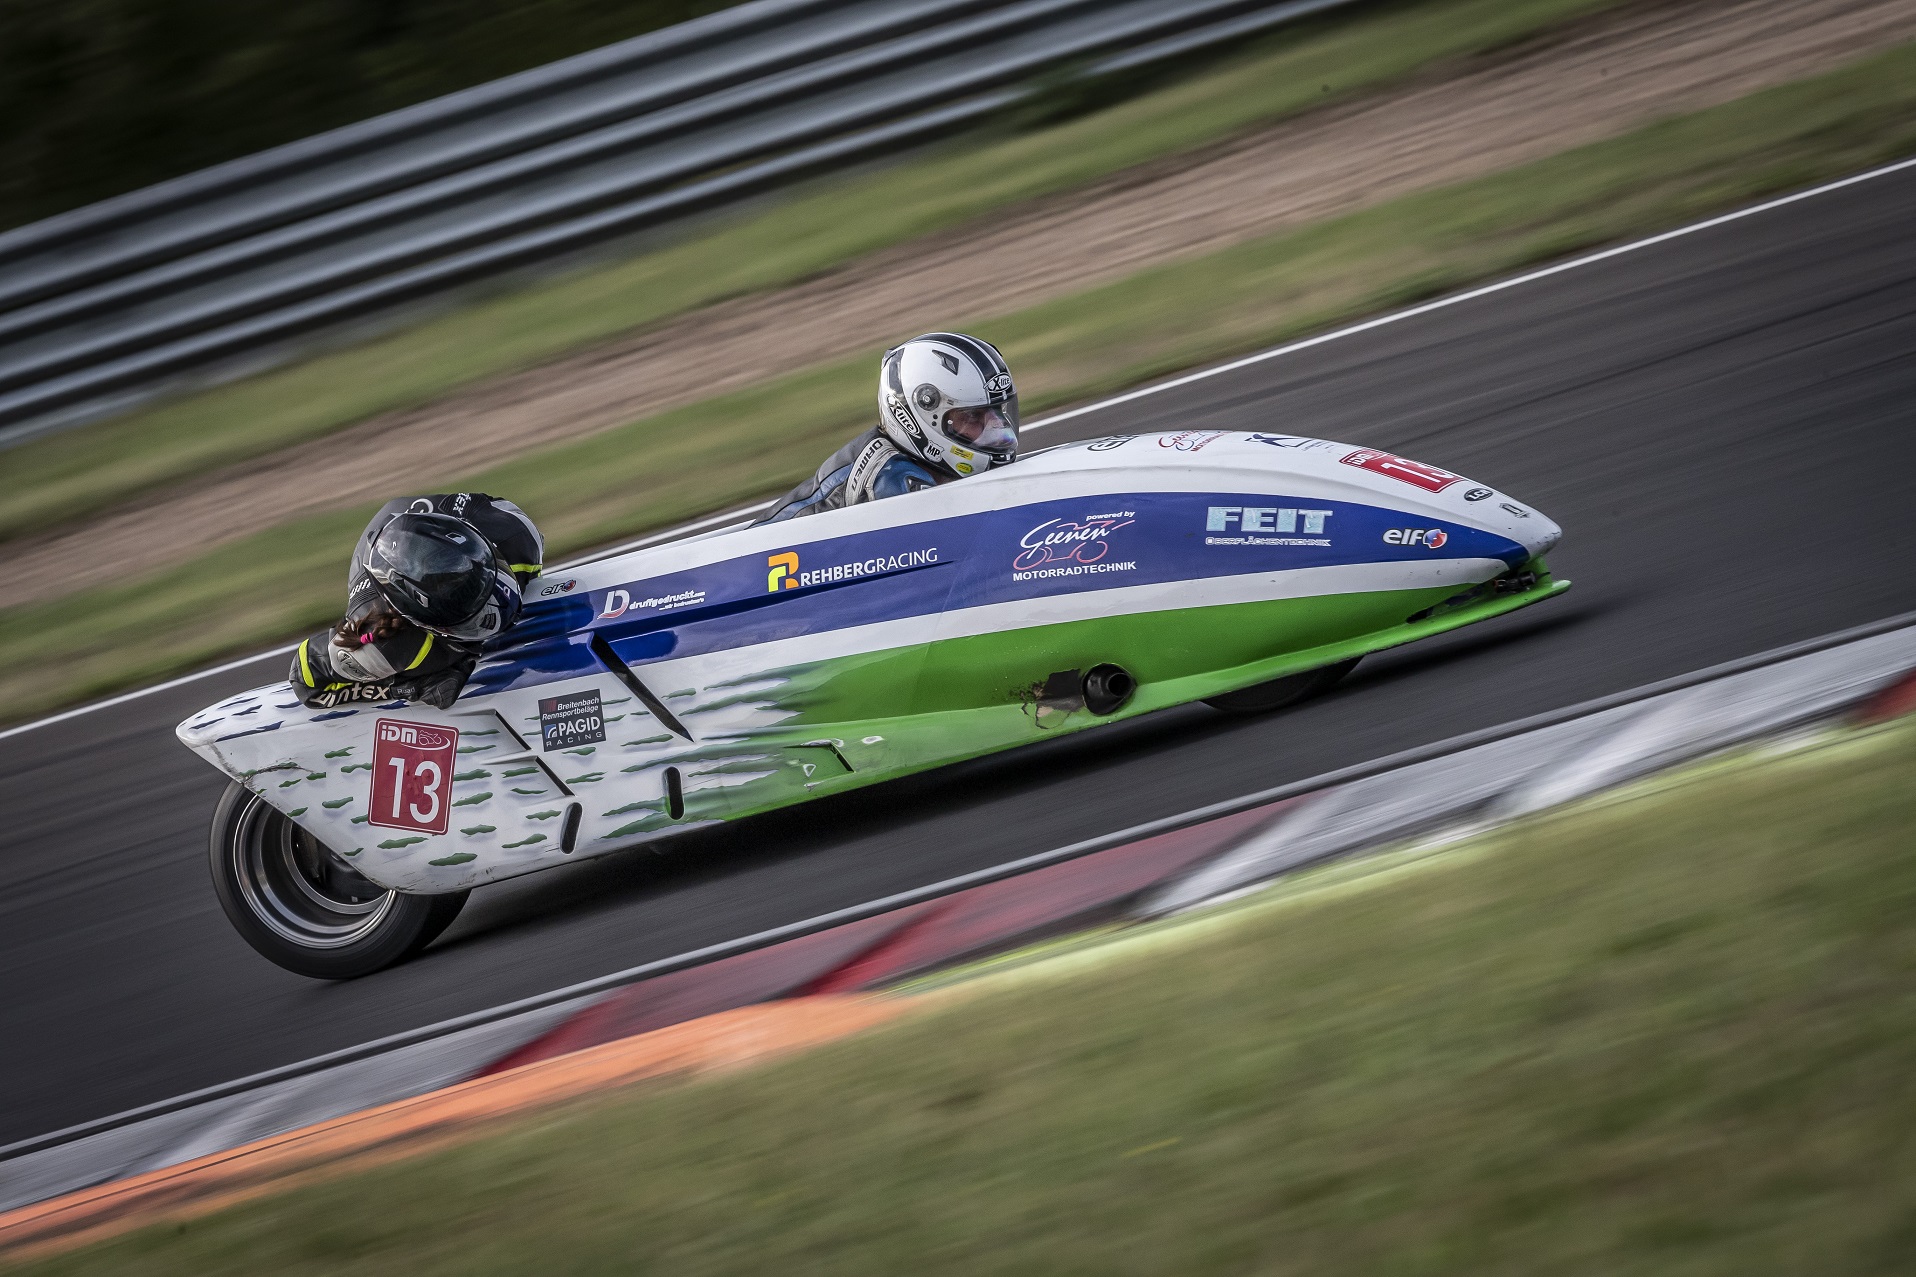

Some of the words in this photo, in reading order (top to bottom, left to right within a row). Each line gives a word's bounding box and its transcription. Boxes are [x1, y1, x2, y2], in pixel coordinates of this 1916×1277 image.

[890, 400, 915, 433] X-lite
[926, 445, 941, 457] MP
[1086, 511, 1122, 521] powered
[1123, 510, 1136, 518] by
[1205, 506, 1334, 534] FEIT
[1382, 528, 1425, 546] elf
[1012, 561, 1137, 581] MOTORRADTECHNIK
[541, 705, 599, 721] Rennsportbeläge
[557, 697, 600, 711] Breitenbach
[558, 716, 601, 737] PAGID
[545, 731, 603, 747] RACING
[388, 756, 442, 824] 13
